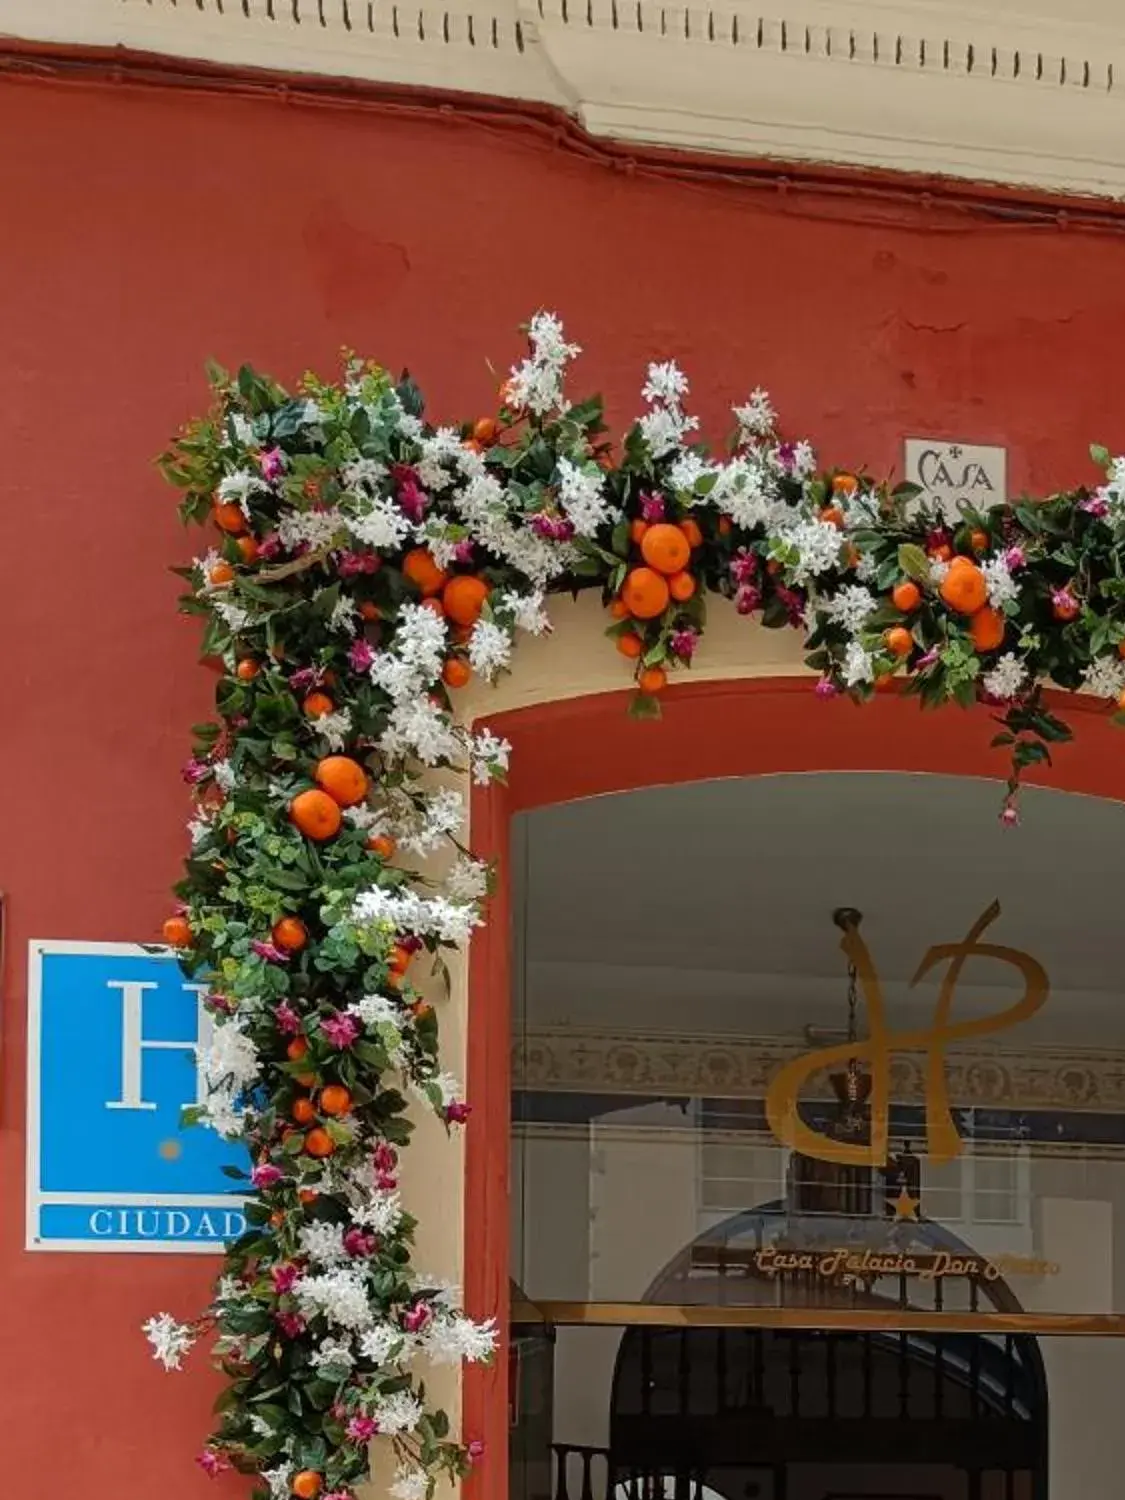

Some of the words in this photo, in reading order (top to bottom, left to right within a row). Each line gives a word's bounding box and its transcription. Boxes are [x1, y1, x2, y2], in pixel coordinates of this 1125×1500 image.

[917, 449, 995, 493] CASA
[105, 980, 217, 1110] H
[89, 1209, 247, 1238] CIUDAD
[755, 1246, 814, 1274] Casa
